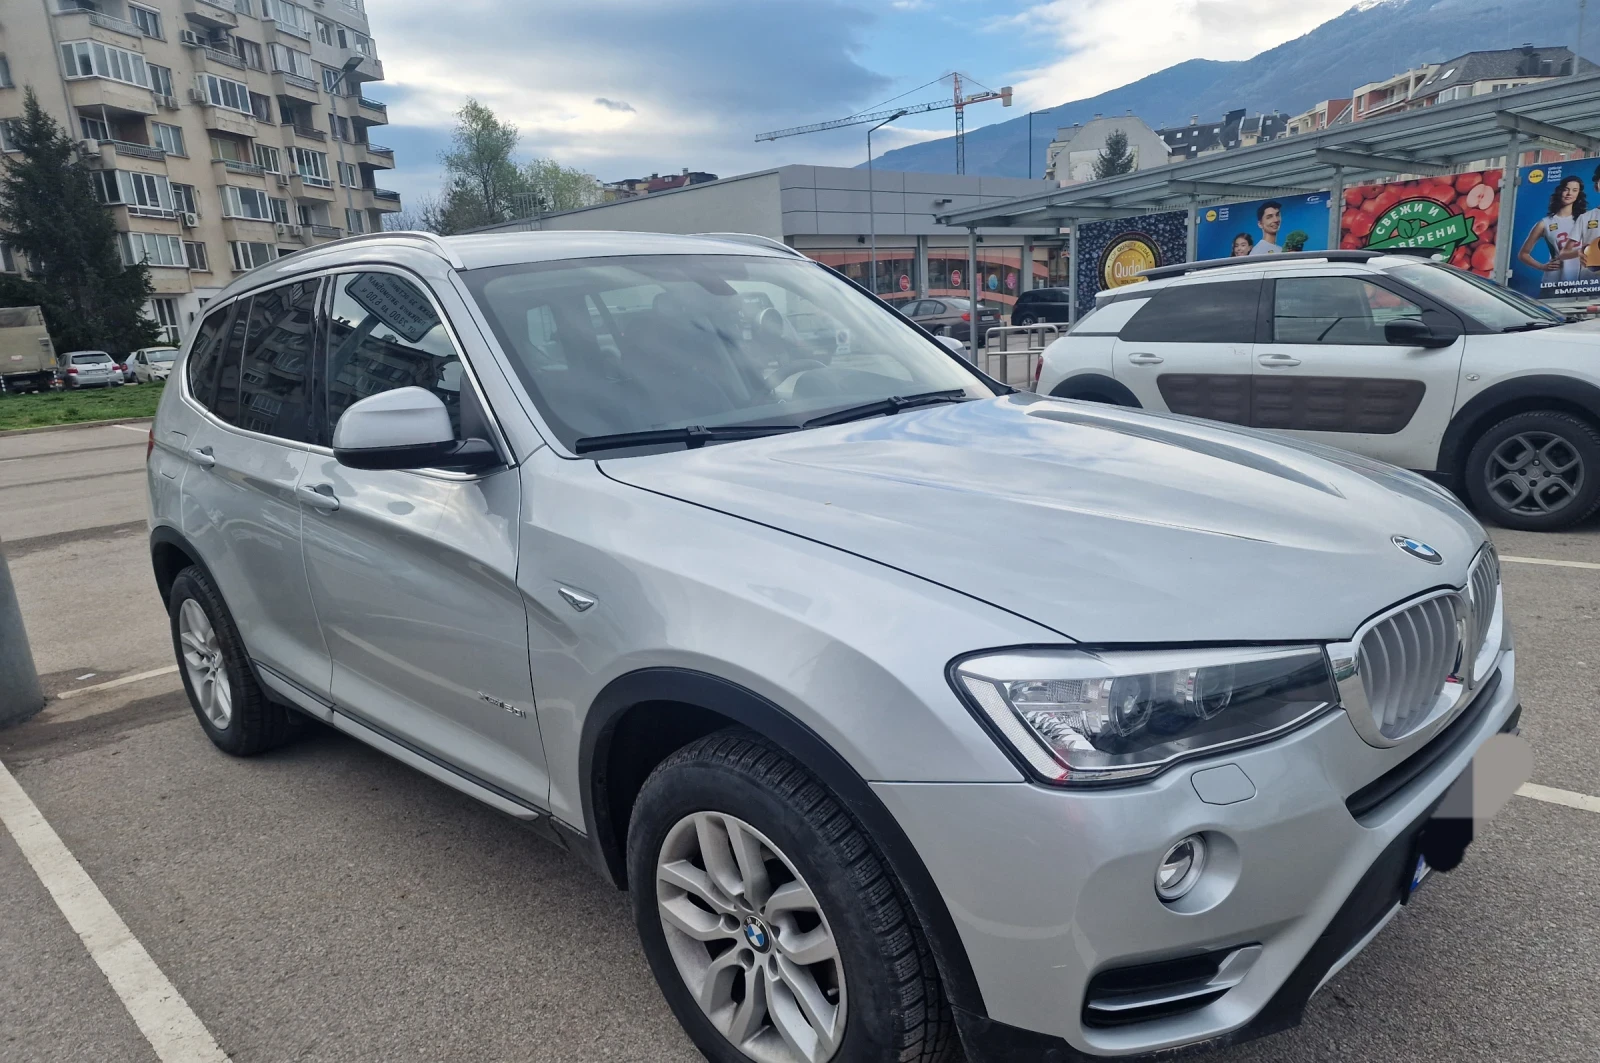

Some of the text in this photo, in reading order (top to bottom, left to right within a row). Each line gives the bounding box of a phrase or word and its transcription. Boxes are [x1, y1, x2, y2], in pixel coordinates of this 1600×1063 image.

[1376, 203, 1439, 235] СВЕЖИ И
[1557, 279, 1589, 287] ПОМАГА
